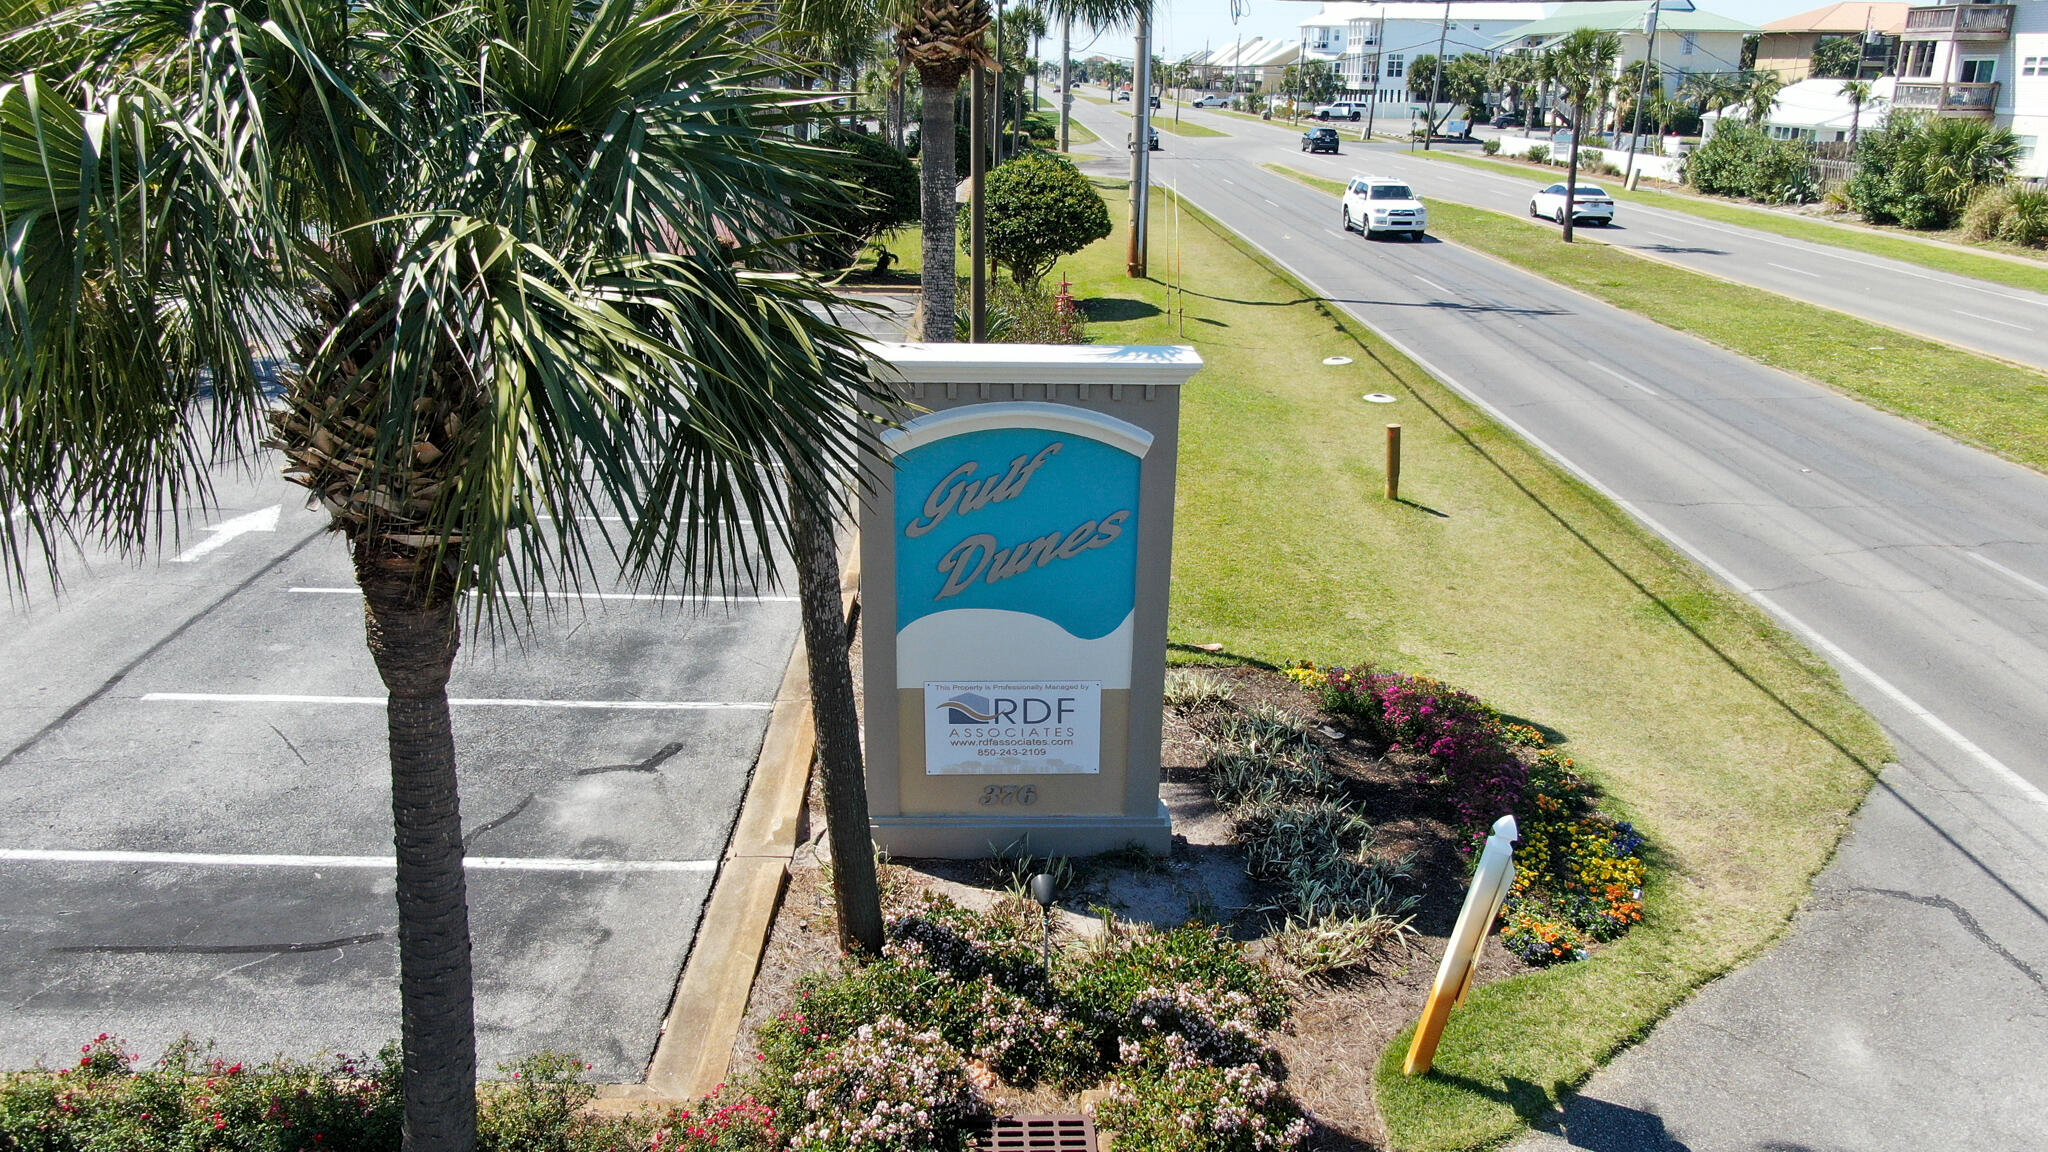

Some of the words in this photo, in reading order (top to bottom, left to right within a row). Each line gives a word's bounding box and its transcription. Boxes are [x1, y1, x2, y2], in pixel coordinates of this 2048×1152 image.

[905, 441, 1064, 538] Gulf
[933, 509, 1131, 601] Dunes
[952, 684, 983, 692] Property
[993, 684, 1044, 692] Professionally
[1045, 684, 1079, 692] Managed
[1080, 684, 1089, 692] by
[994, 698, 1075, 725] RDF
[949, 727, 1074, 738] ASSOCIATES
[950, 737, 1073, 747] www.rdfassociates.com
[977, 748, 1047, 757] 850-243-2109
